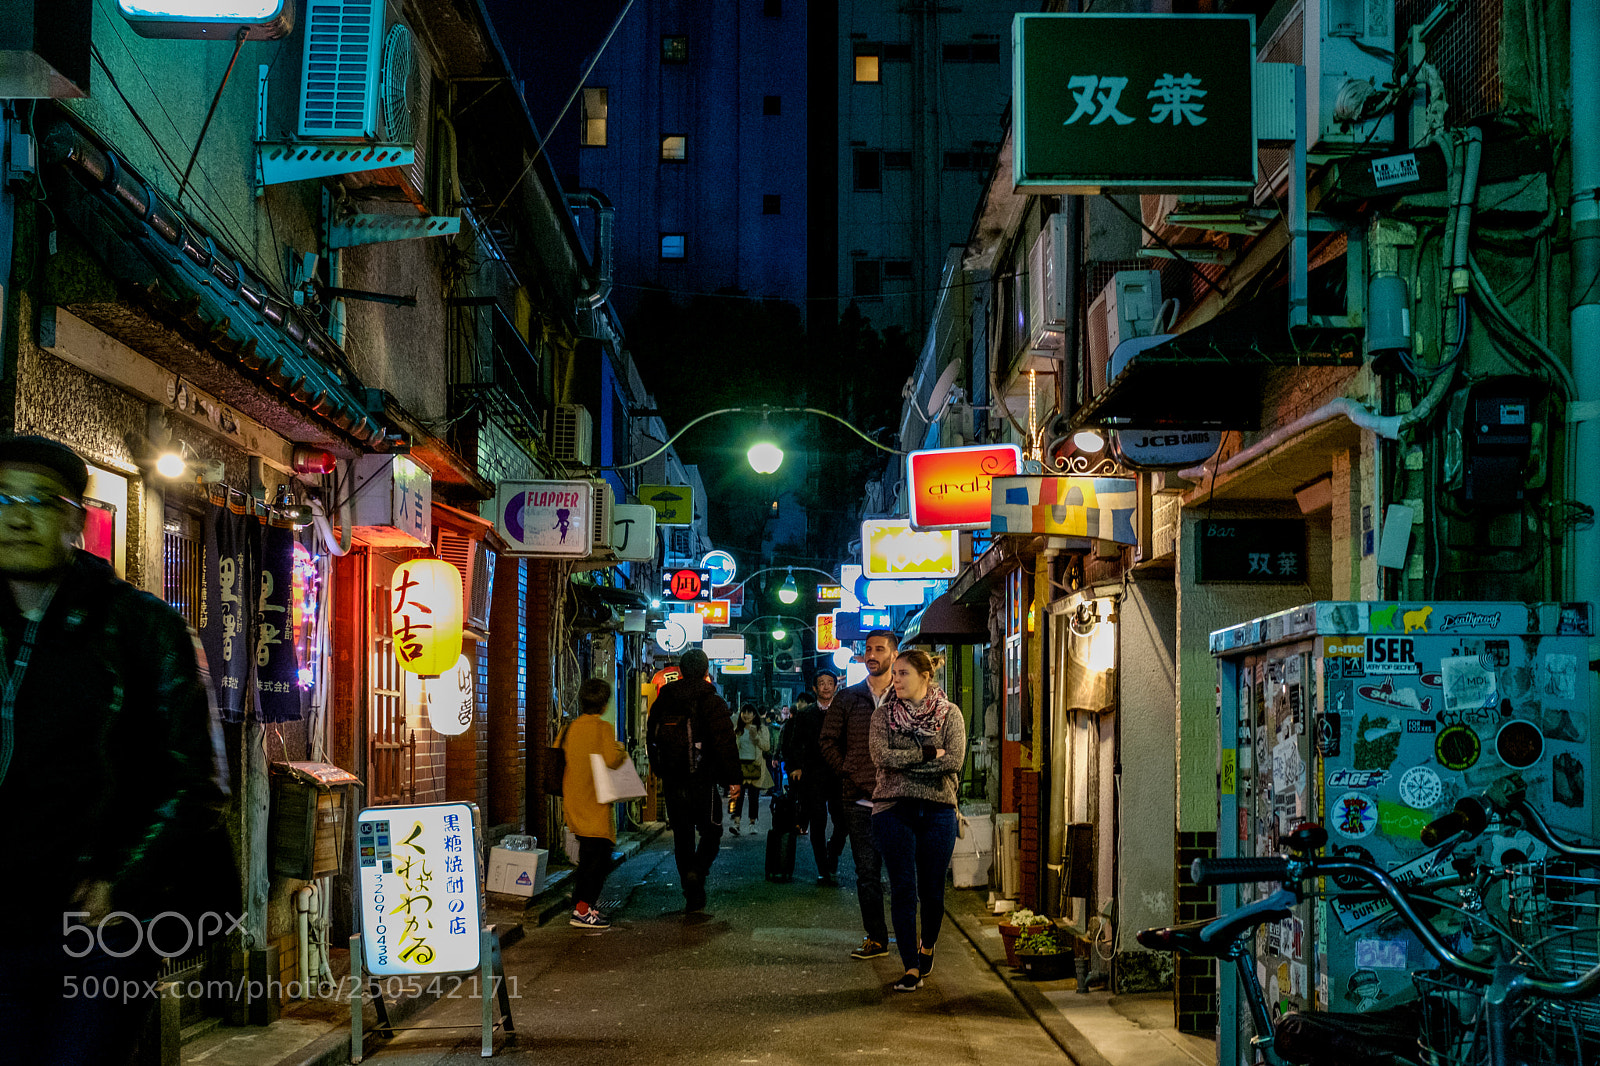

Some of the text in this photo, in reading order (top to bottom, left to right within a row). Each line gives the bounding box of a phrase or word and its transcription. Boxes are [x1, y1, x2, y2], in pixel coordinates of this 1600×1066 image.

[1062, 72, 1209, 128] 双葉
[1134, 432, 1210, 448] JCB CARDS
[398, 483, 425, 529] 大吉
[527, 491, 579, 508] FLAPPER
[1247, 551, 1299, 576] 双葉
[392, 568, 433, 663] 大吉
[1365, 663, 1416, 671] VERY TOP SECRET
[1366, 638, 1415, 663] ISER
[1329, 769, 1370, 788] CAGE
[443, 813, 467, 936] 黒糖焼酎の店
[391, 821, 436, 966] くればわかる
[373, 873, 388, 966] 3209-0438
